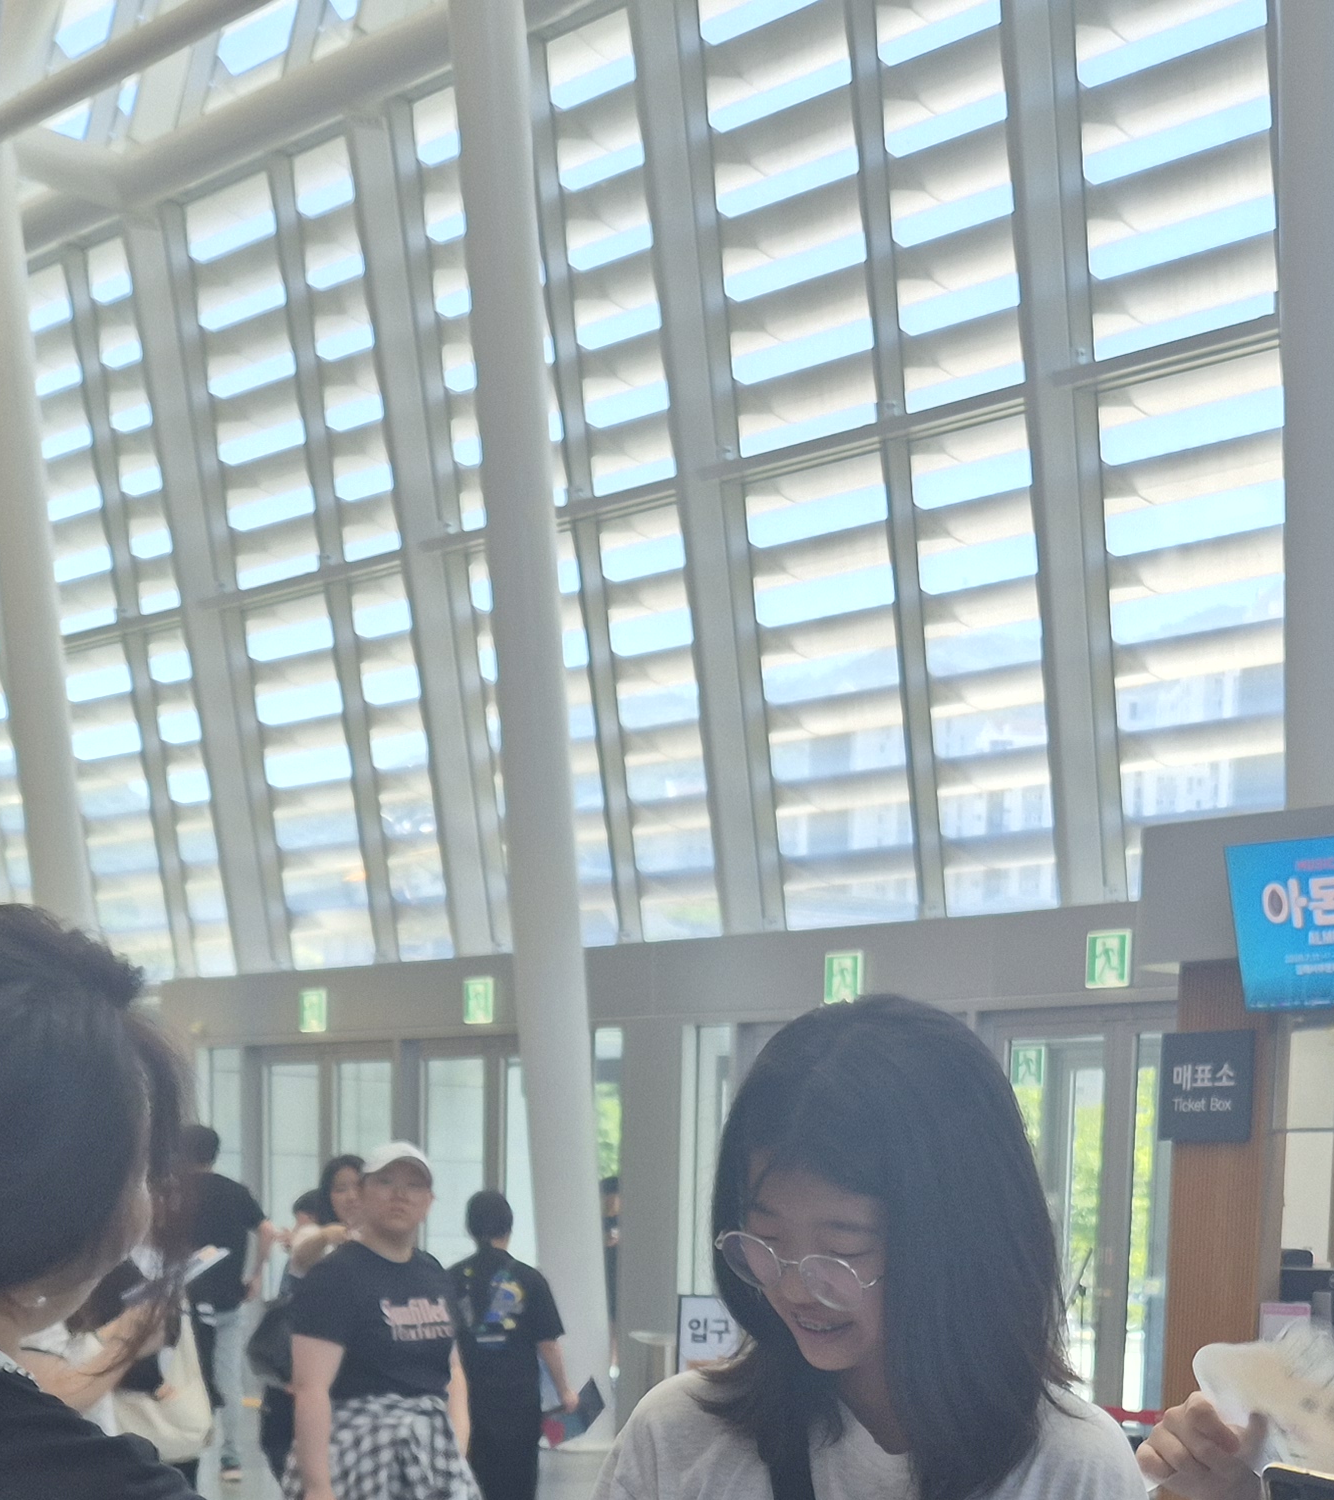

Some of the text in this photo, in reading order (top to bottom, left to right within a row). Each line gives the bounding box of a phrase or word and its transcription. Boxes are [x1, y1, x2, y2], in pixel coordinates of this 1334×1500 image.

[1172, 1062, 1235, 1091] 매표소
[1172, 1096, 1232, 1112] Ticket Box
[688, 1318, 731, 1344] 입구
